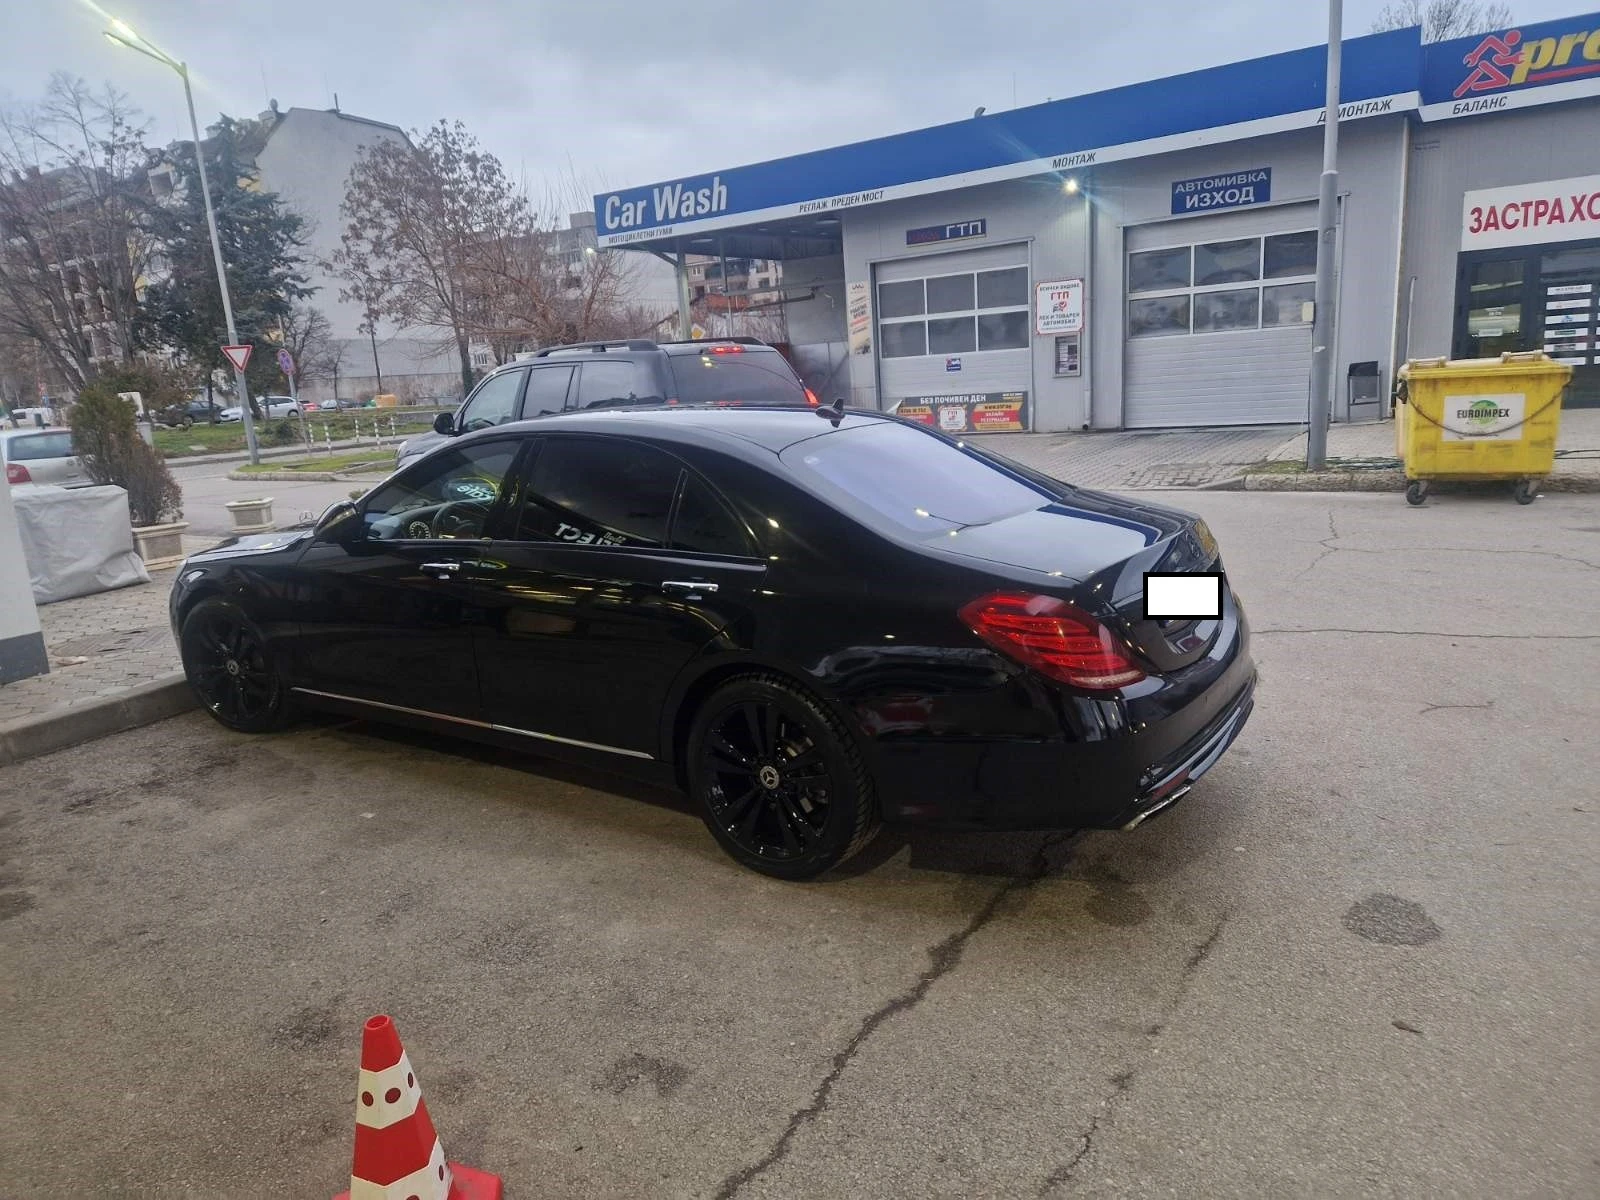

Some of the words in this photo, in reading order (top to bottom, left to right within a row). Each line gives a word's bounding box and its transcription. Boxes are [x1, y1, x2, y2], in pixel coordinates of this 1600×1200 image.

[1317, 99, 1392, 124] ДМОНТАЖ
[1452, 96, 1507, 115] БАЛАНС
[1052, 152, 1096, 169] МОНТАЖ
[1175, 171, 1268, 194] АВТОМИВКА
[605, 195, 646, 230] Car
[653, 176, 727, 222] Wash
[831, 194, 860, 207] ПРЕДЕН
[861, 190, 884, 203] МОСТ
[1185, 186, 1255, 210] ИЗХОД
[946, 221, 982, 239] ГТП
[1050, 291, 1070, 300] ГТП
[920, 397, 934, 405] БЕЗ
[935, 394, 969, 404] ПОЧИВЕН
[970, 394, 987, 404] ДЕН
[1457, 408, 1511, 419] EUROIMPEX
